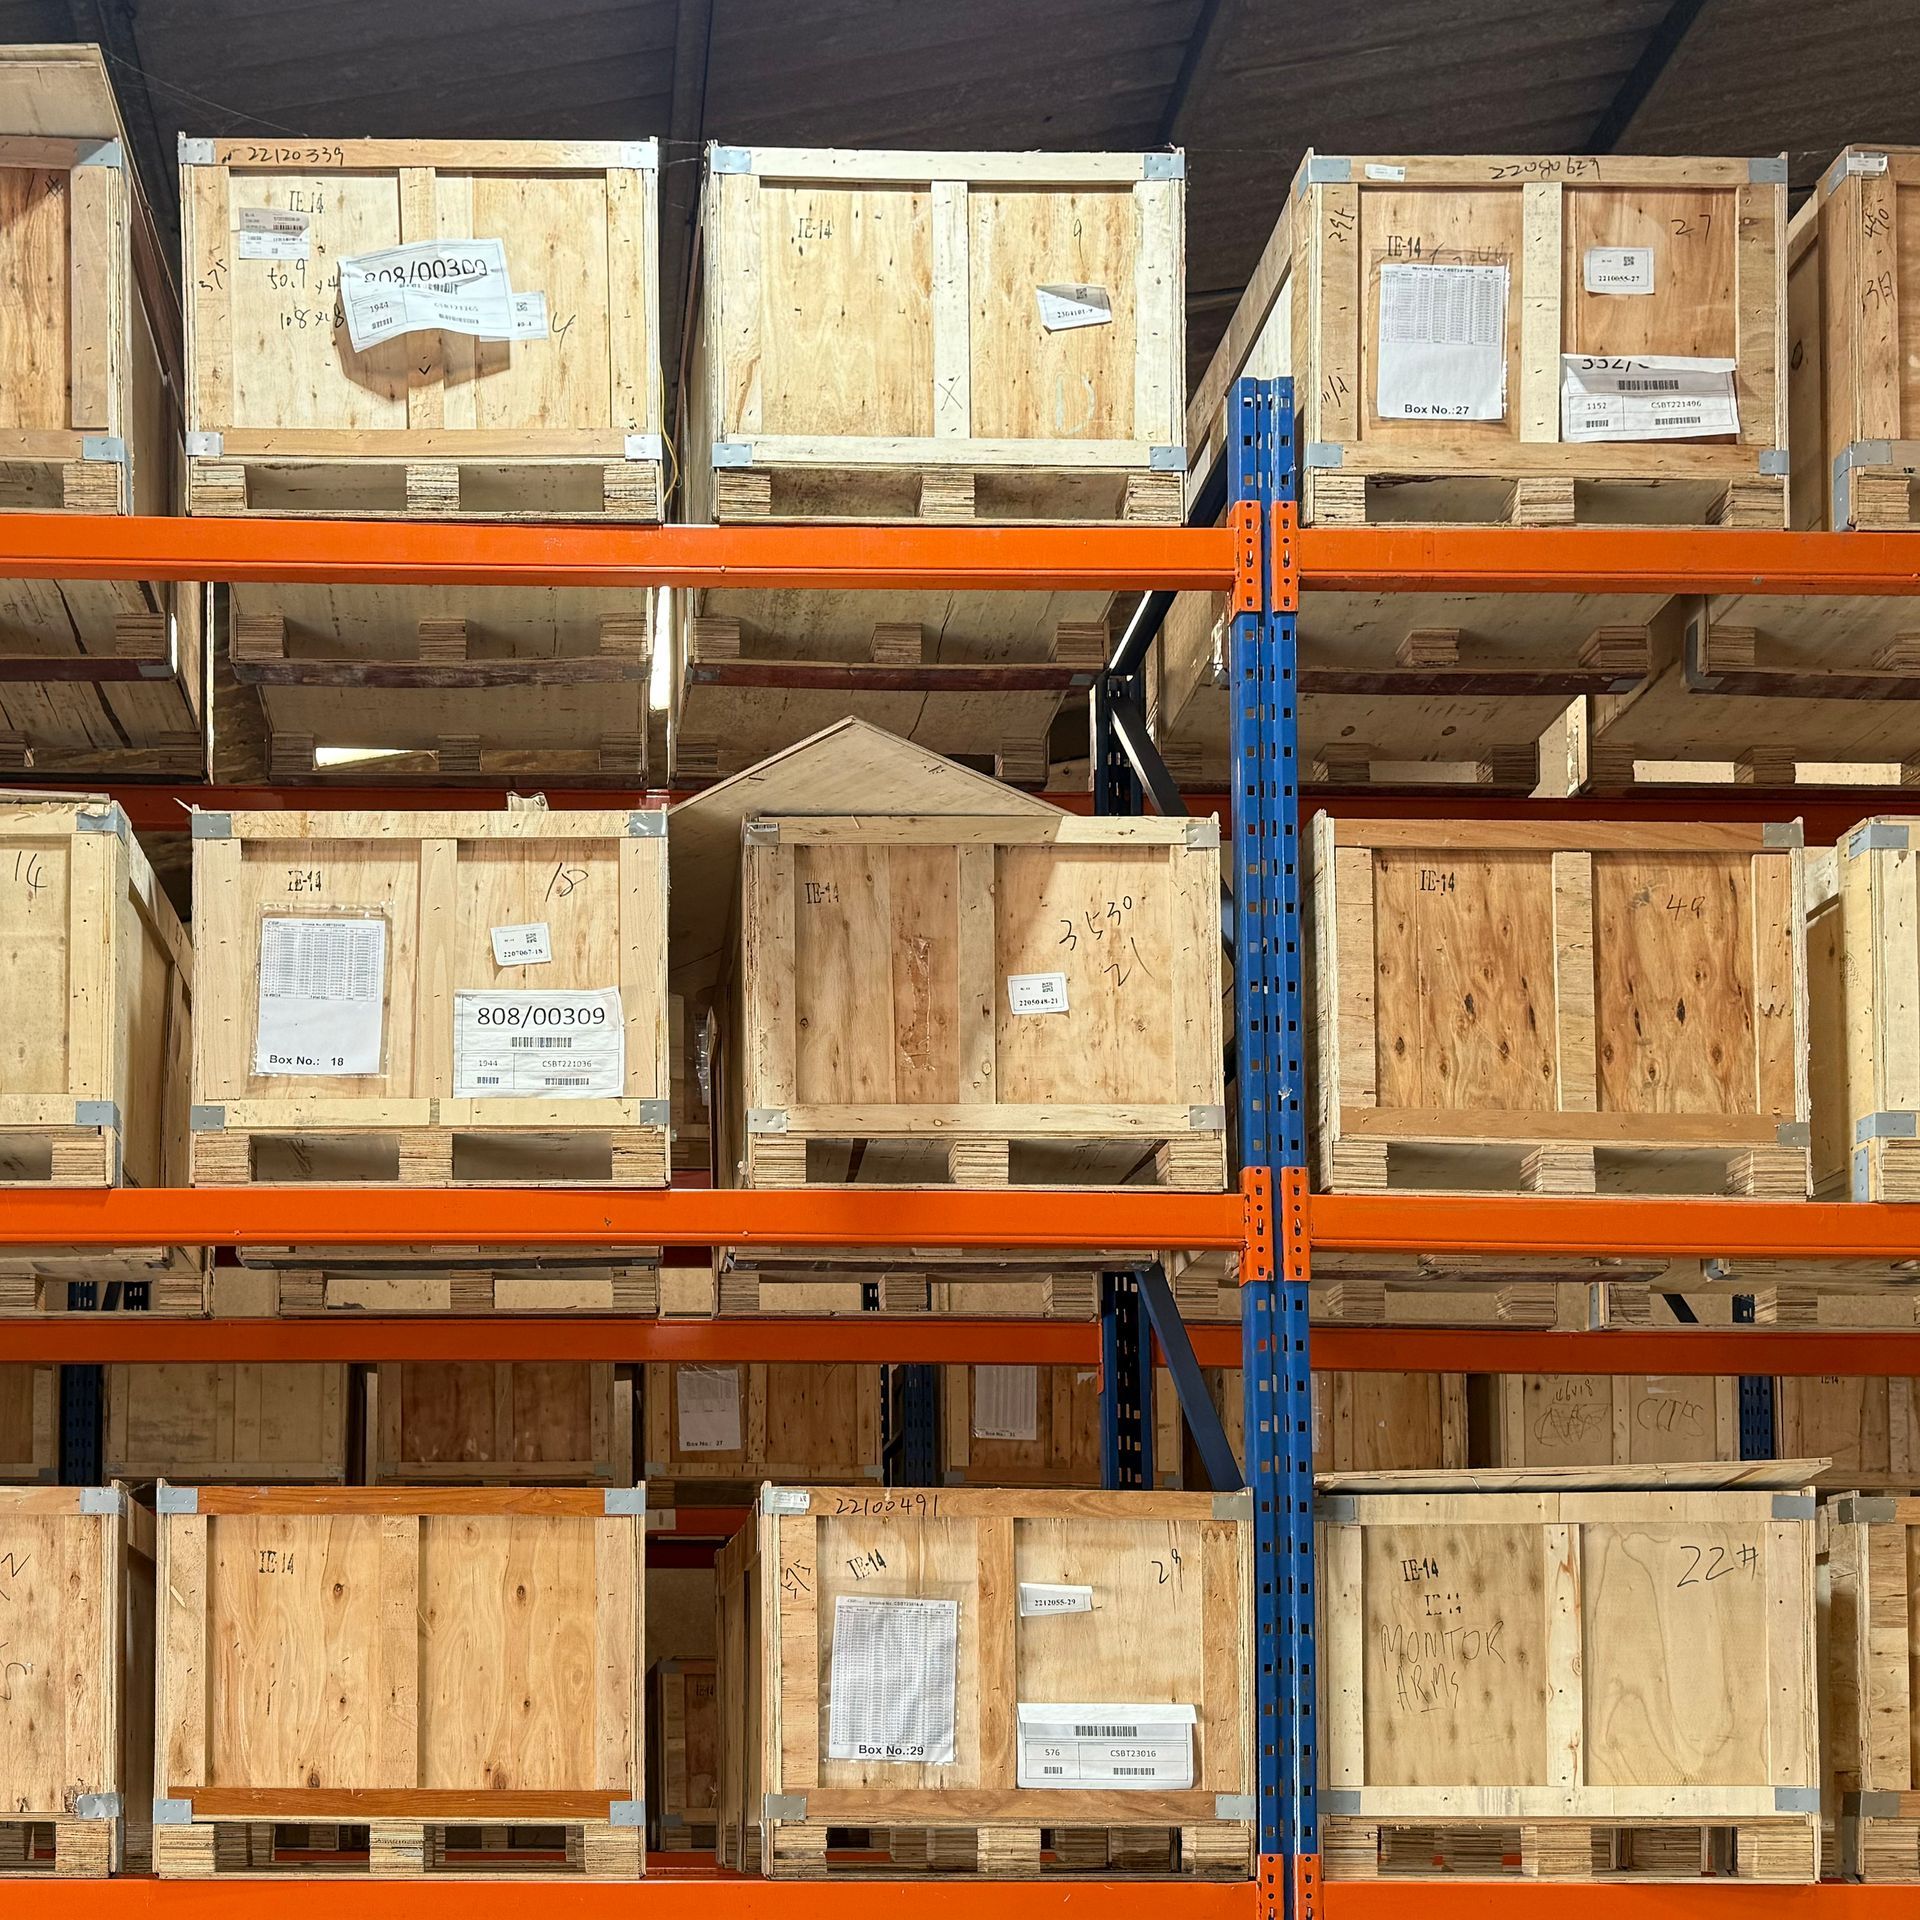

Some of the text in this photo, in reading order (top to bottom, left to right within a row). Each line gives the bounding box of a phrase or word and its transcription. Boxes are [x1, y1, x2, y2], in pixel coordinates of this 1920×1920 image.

[248, 147, 344, 166] 22120339
[1671, 214, 1711, 245] 27
[1387, 235, 1421, 258] IE-14
[1404, 404, 1428, 414] Box
[1587, 402, 1607, 410] 1152
[14, 850, 49, 900] 14
[1420, 869, 1456, 893] IE-14
[805, 882, 841, 905] IE-14
[477, 1005, 606, 1029] 808/00309
[269, 1054, 345, 1067] Box No.: 18
[479, 1059, 499, 1068] 1944
[542, 1060, 593, 1068] CSBT221036
[836, 1493, 938, 1518] 22100491
[847, 1548, 887, 1582] IE-14
[1400, 1557, 1440, 1582] IE-14
[1380, 1619, 1506, 1672] MONITOR
[1396, 1662, 1459, 1712] ARMS
[858, 1744, 882, 1755] Box
[1044, 1749, 1060, 1757] 576
[1110, 1749, 1157, 1758] CSBT23016
